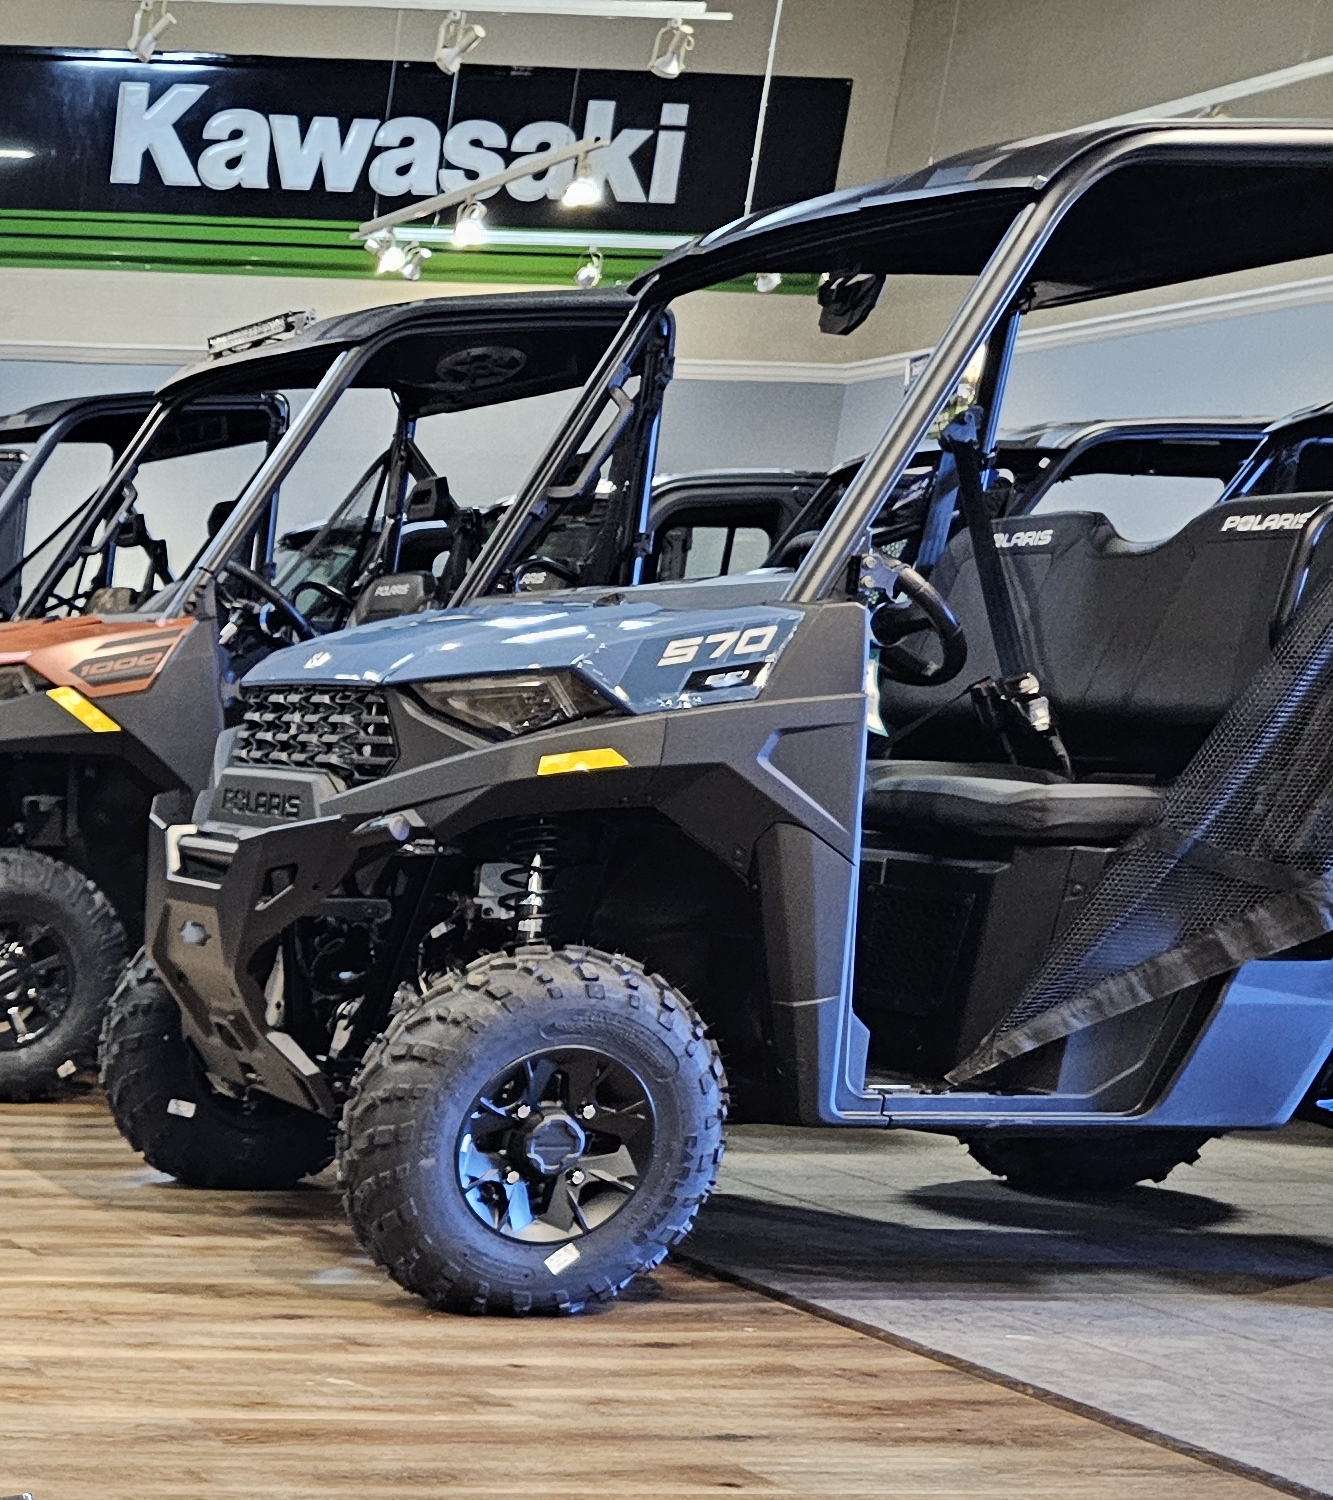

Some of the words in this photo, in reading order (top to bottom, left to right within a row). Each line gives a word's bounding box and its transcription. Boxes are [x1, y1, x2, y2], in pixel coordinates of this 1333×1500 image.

[109, 81, 690, 205] Kawasaki
[993, 529, 1054, 548] OLARIS
[80, 651, 163, 677] 1000
[222, 787, 302, 818] POLARIS
